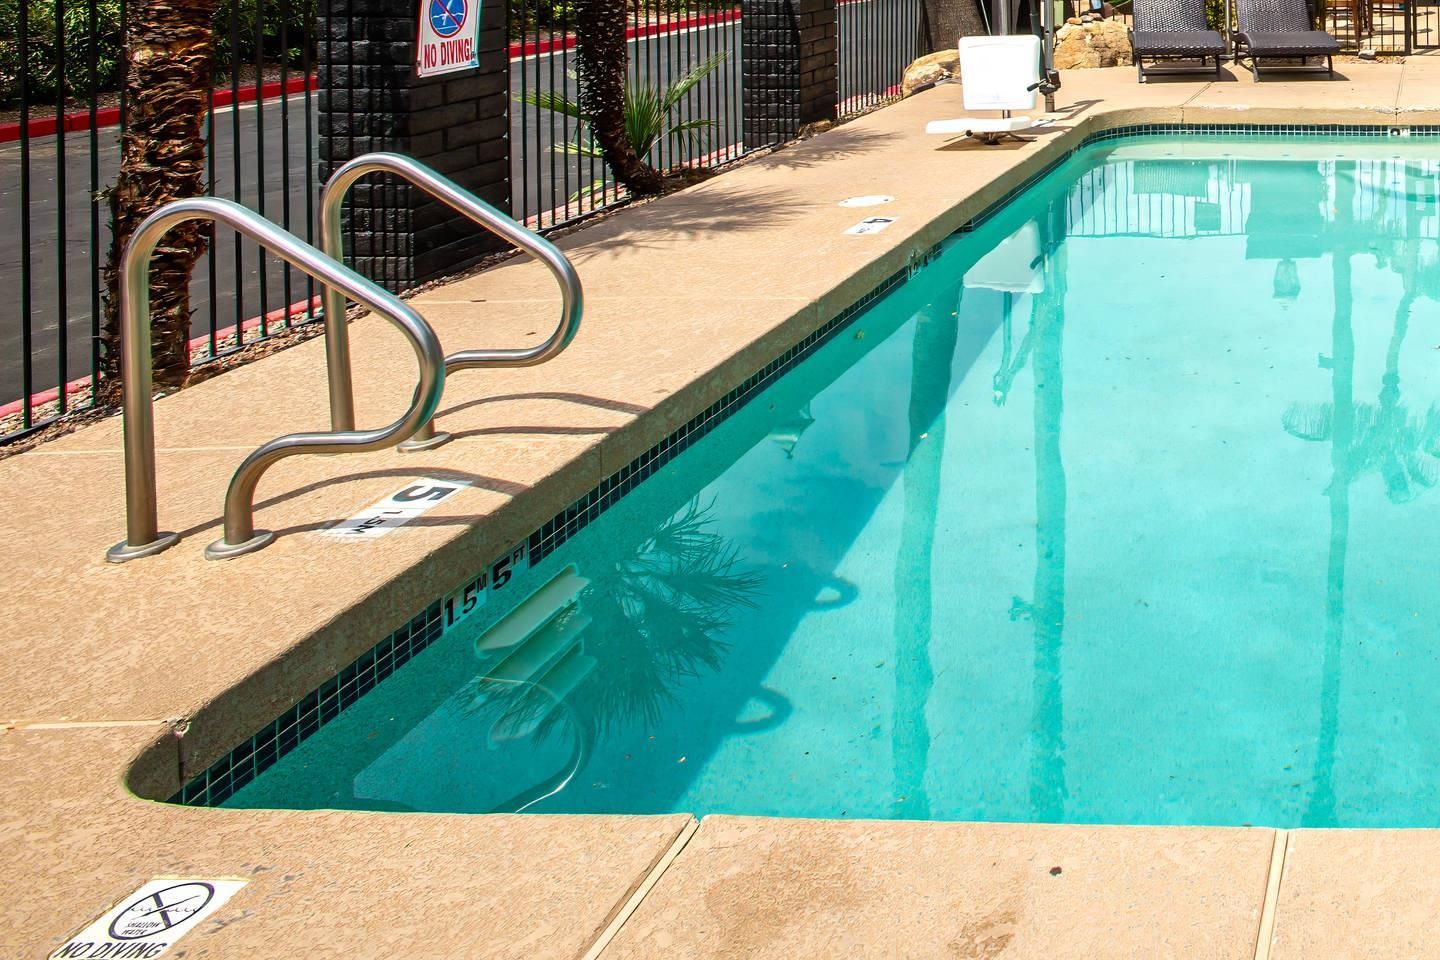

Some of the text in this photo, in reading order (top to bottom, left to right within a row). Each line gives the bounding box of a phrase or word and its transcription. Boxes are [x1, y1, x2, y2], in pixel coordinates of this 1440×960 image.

[424, 38, 473, 69] NO DIVING!
[392, 485, 458, 502] 5
[53, 942, 168, 959] NO DIVING
